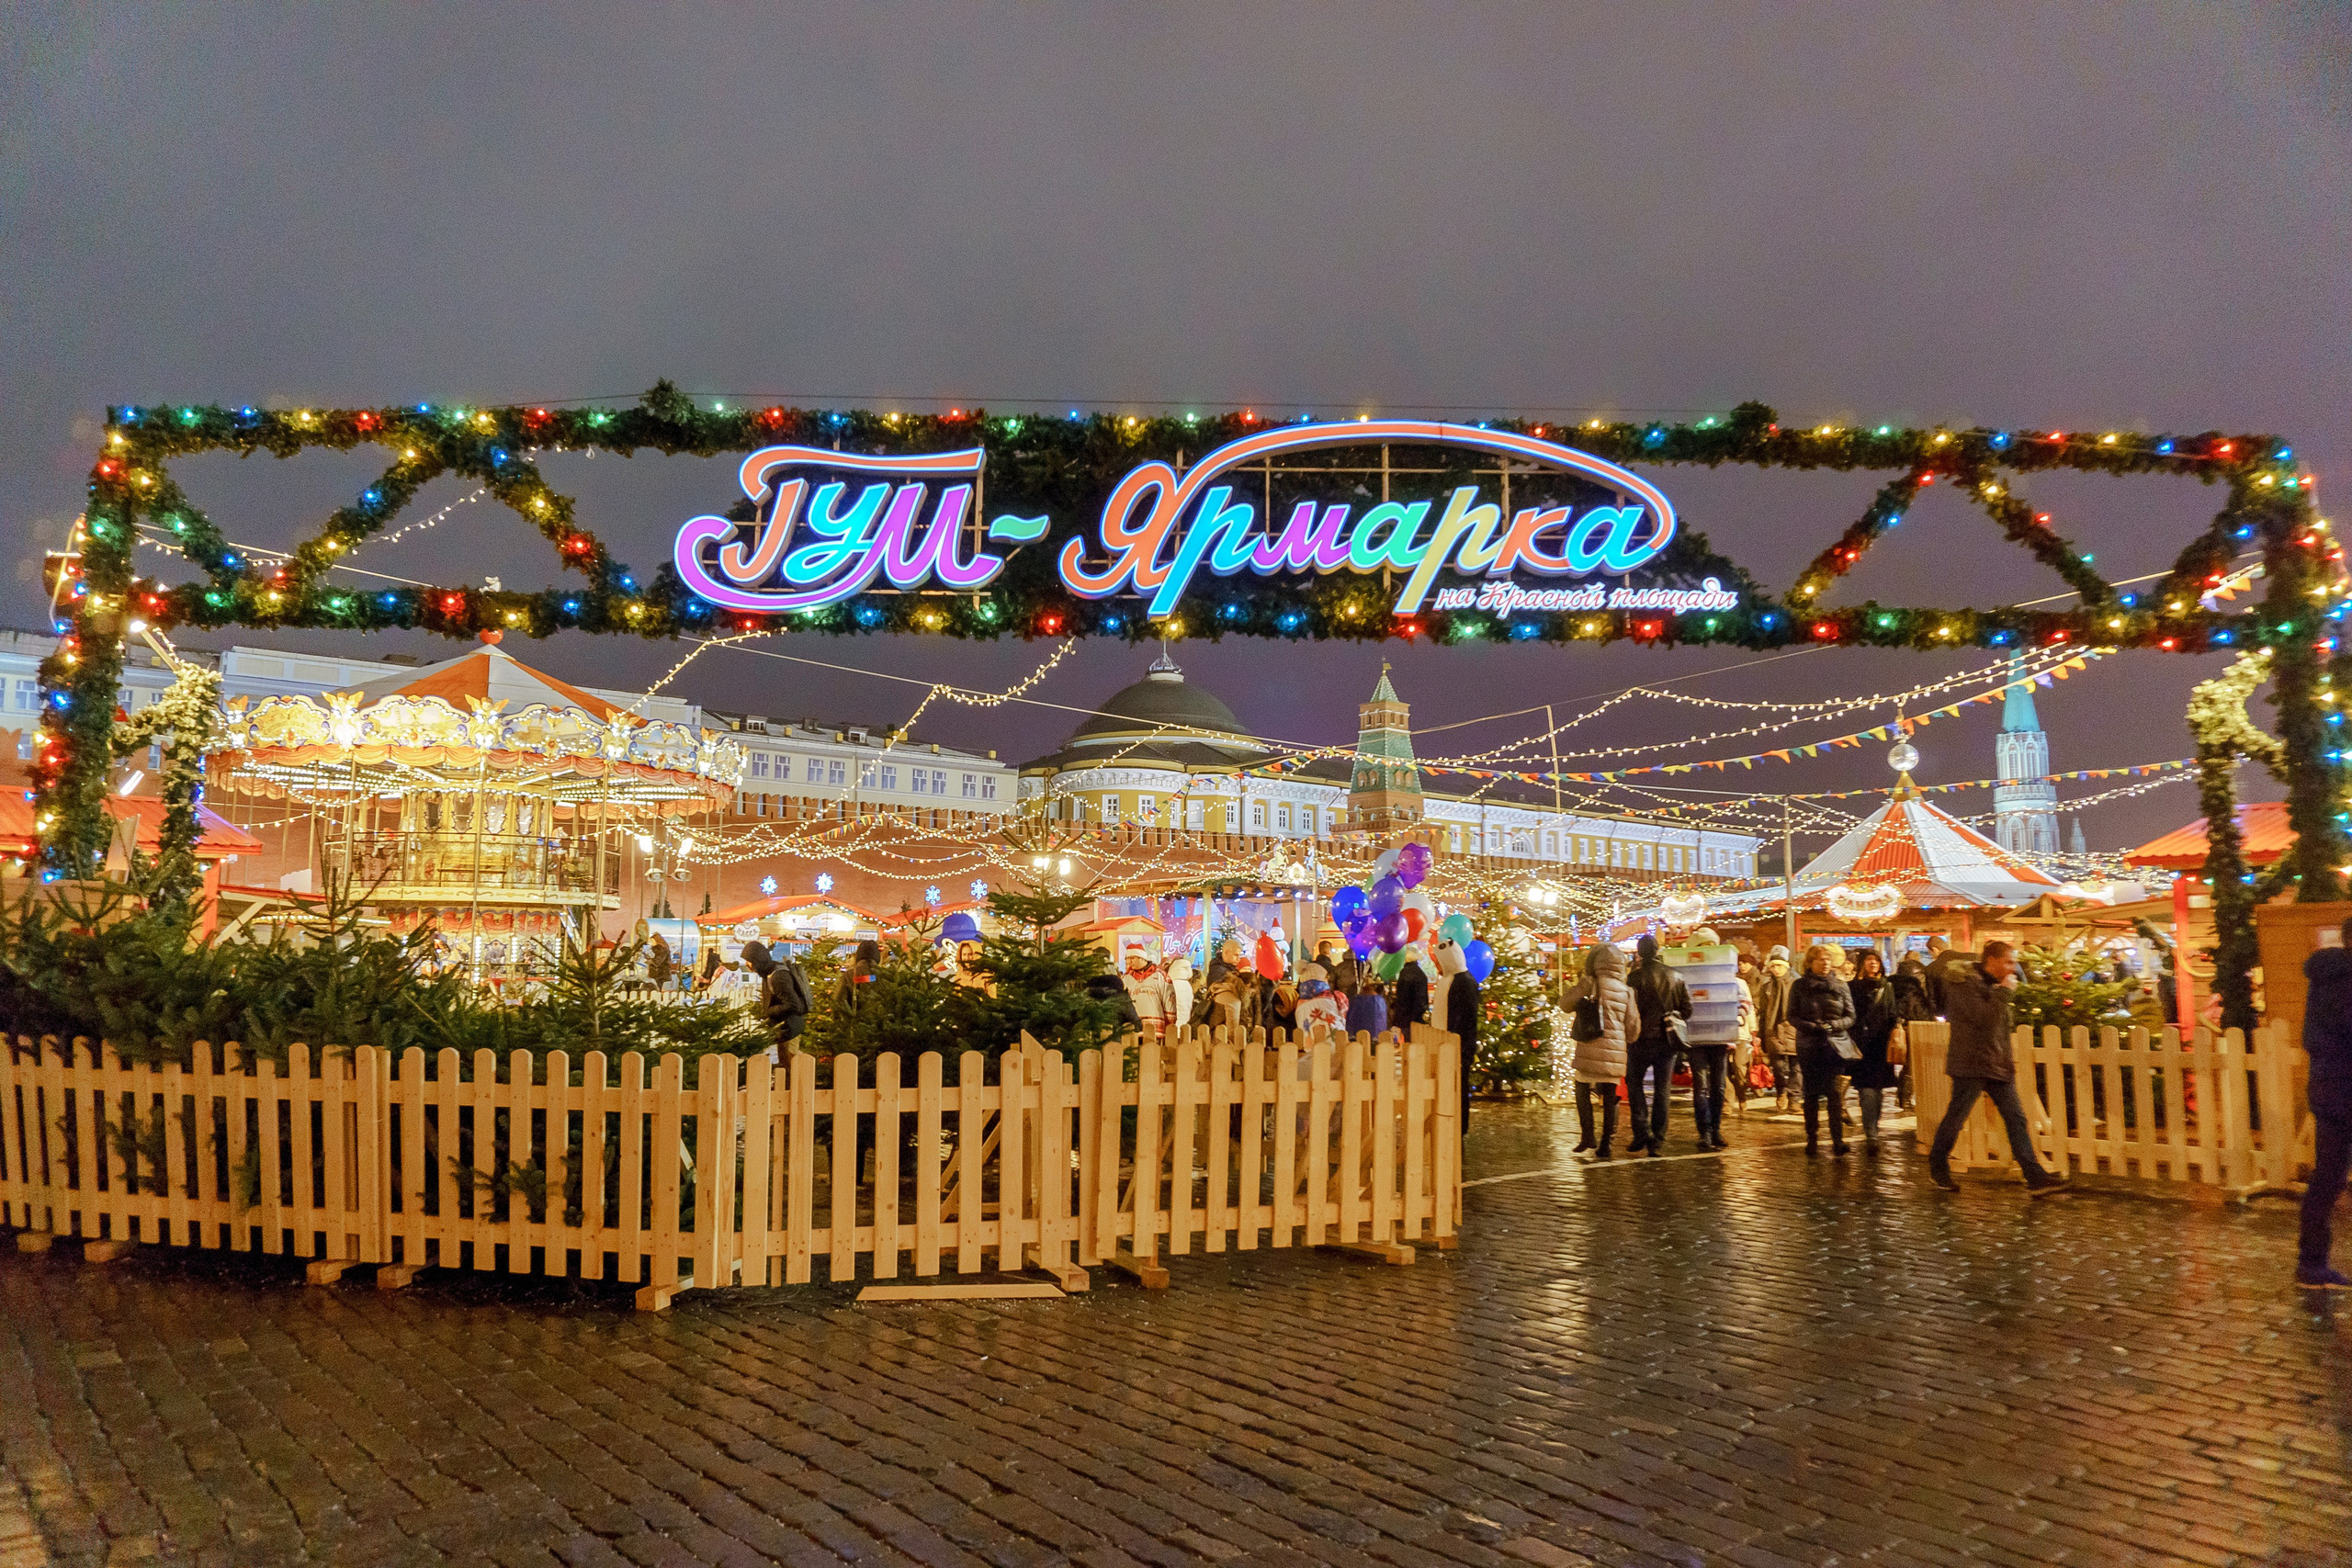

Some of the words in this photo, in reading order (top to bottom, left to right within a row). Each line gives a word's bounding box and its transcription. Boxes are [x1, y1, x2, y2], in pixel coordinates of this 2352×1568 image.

[1434, 587, 1476, 610] на
[1476, 581, 1606, 620] Красной
[1607, 577, 1738, 615] площади
[736, 927, 759, 937] КАССА
